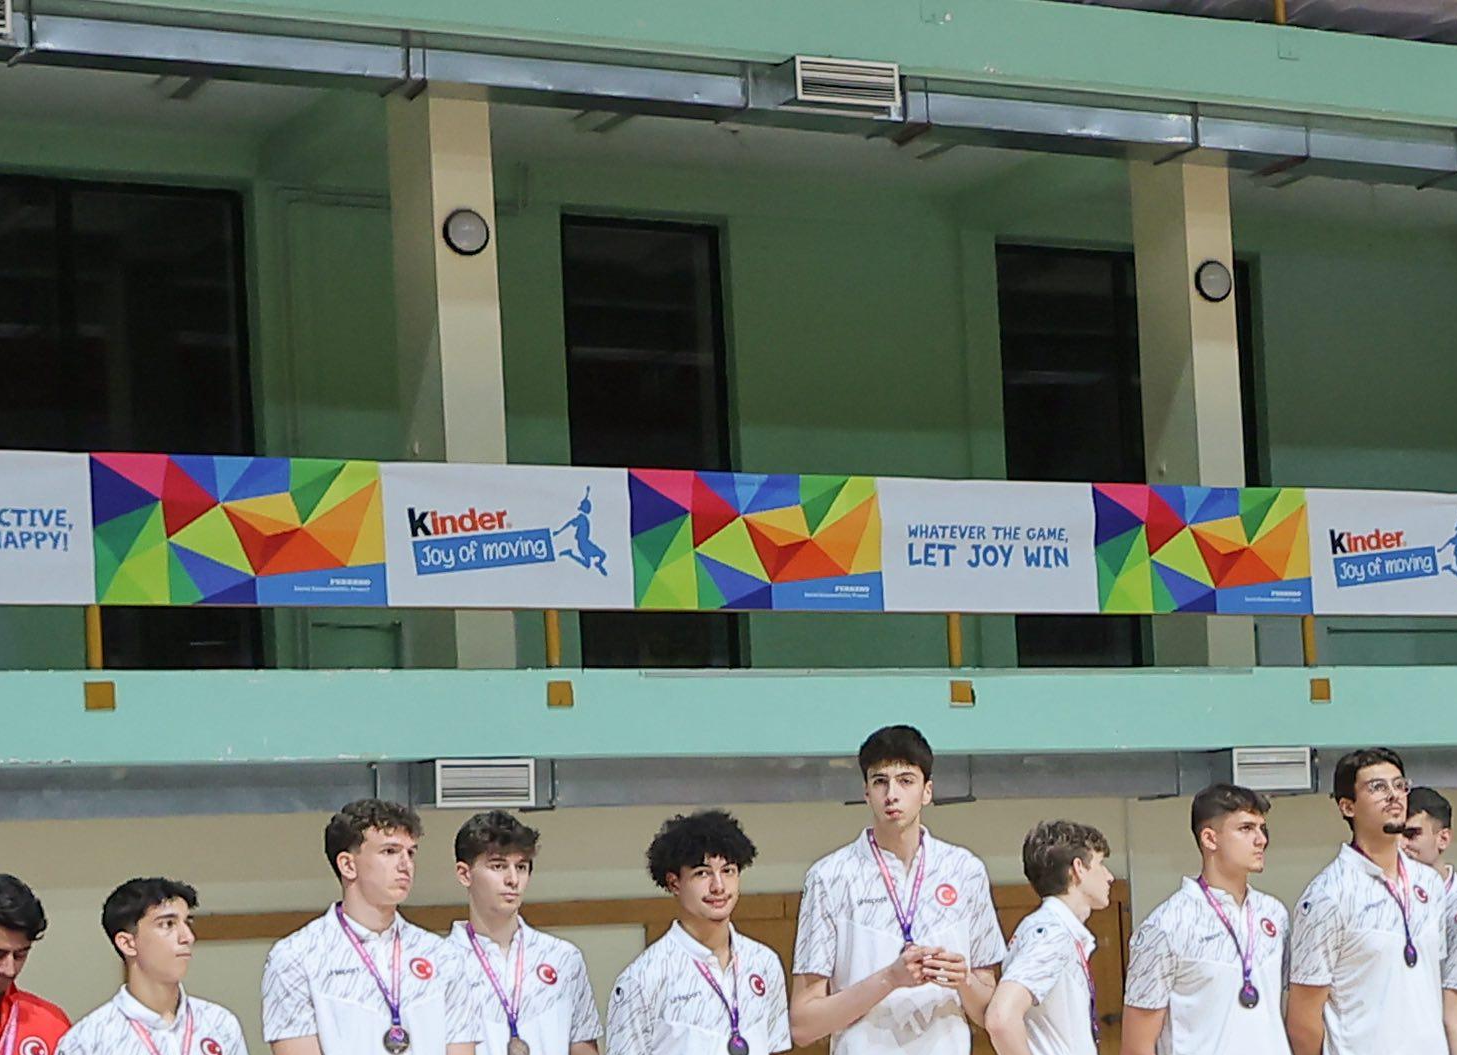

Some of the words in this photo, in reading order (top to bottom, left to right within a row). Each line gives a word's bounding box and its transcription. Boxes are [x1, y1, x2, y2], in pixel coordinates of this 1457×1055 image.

[907, 524, 986, 540] WHATEVER
[992, 526, 1021, 540] THE
[1026, 526, 1069, 543] GAME,
[421, 545, 456, 570] Joy
[458, 540, 478, 563] of
[482, 537, 548, 561] moving
[907, 543, 957, 568] LET
[966, 544, 1015, 569] JOY
[1023, 545, 1069, 569] WIN
[1339, 562, 1365, 581] Joy
[1368, 557, 1383, 577] of
[1385, 553, 1433, 574] moving
